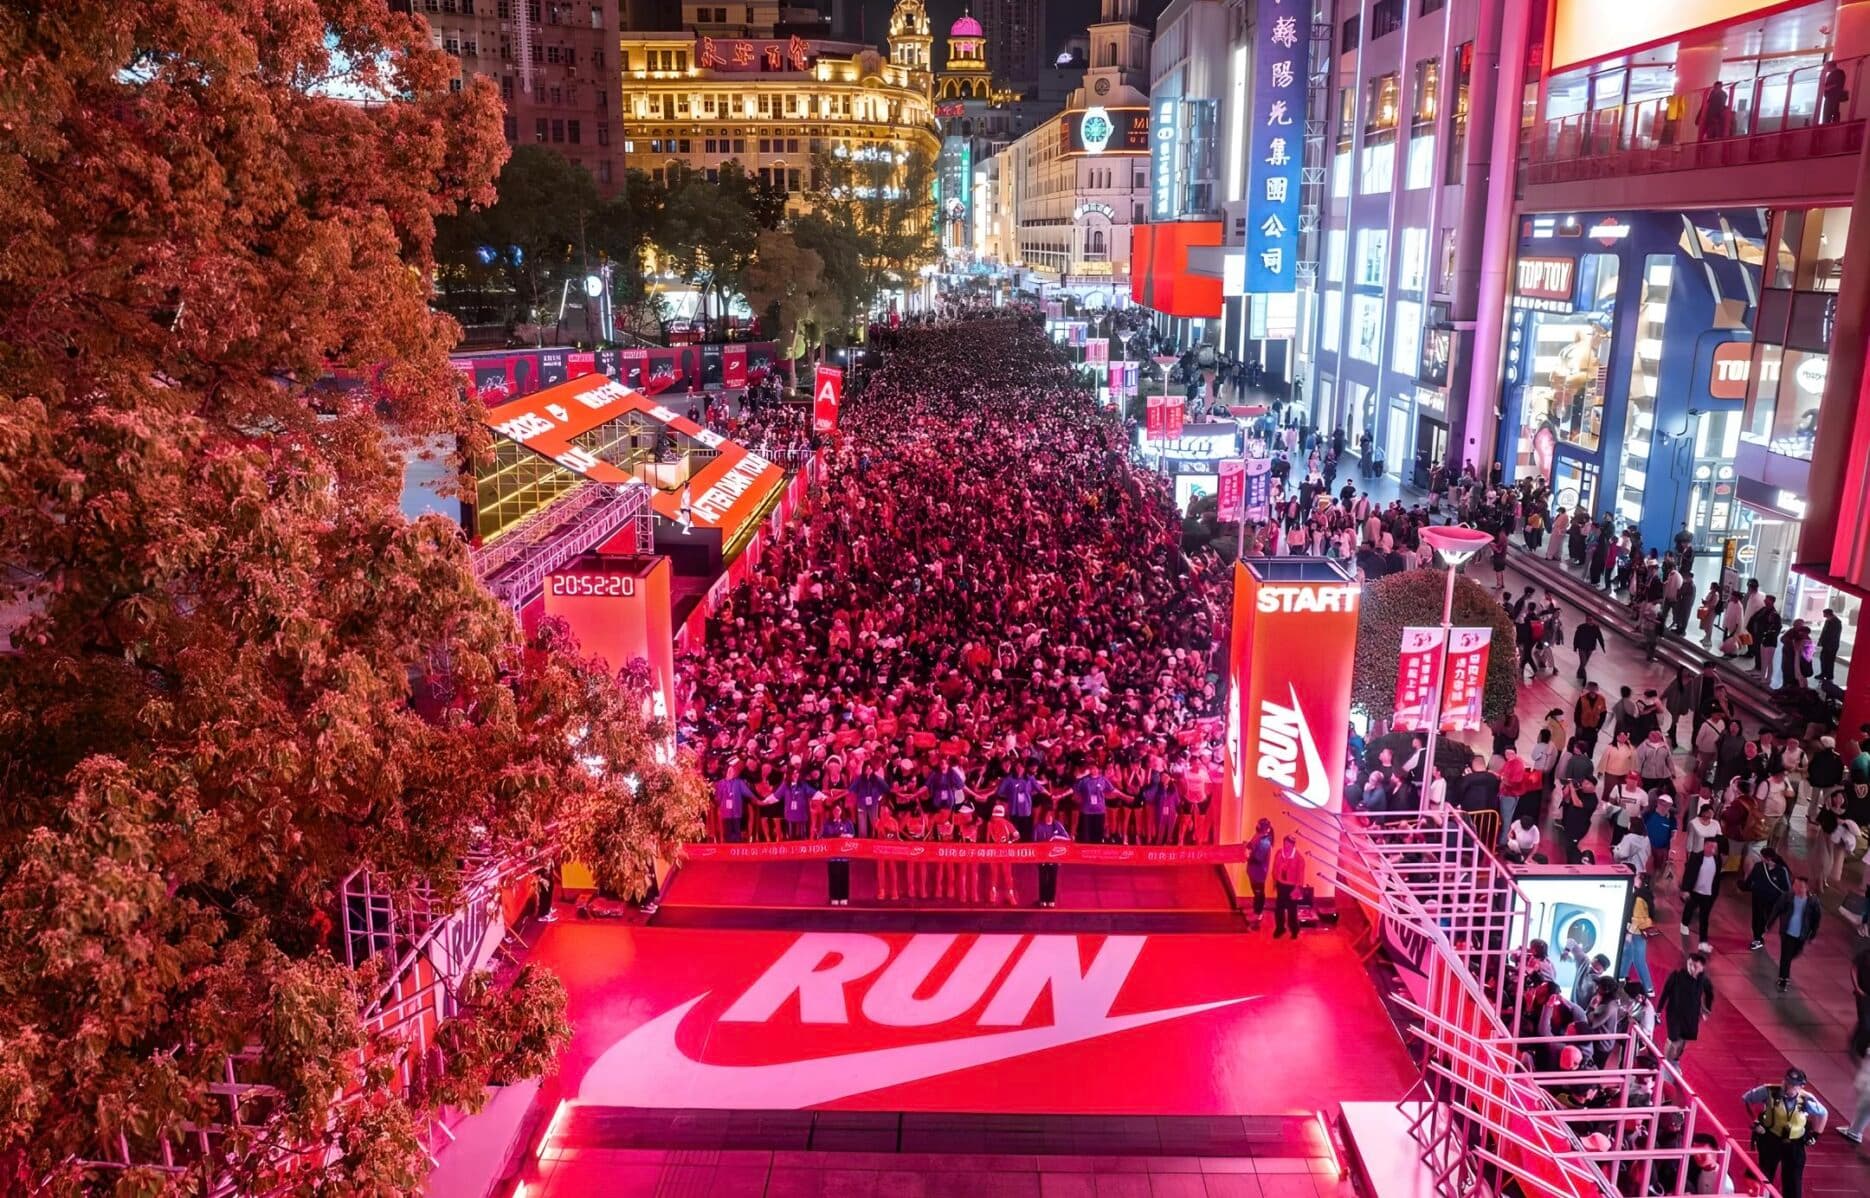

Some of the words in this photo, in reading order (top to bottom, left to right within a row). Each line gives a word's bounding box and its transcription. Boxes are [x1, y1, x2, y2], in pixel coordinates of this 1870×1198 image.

[1260, 0, 1298, 275] 蘇陽光集團公司
[1519, 260, 1544, 289] TOP
[1544, 262, 1571, 293] TOY
[817, 380, 837, 406] A
[691, 487, 737, 525] AFTER
[714, 467, 755, 498] DARK
[553, 575, 634, 596] 20:52:20
[1257, 586, 1360, 613] START
[1257, 699, 1300, 789] RUN
[718, 933, 1147, 1027] RUN
